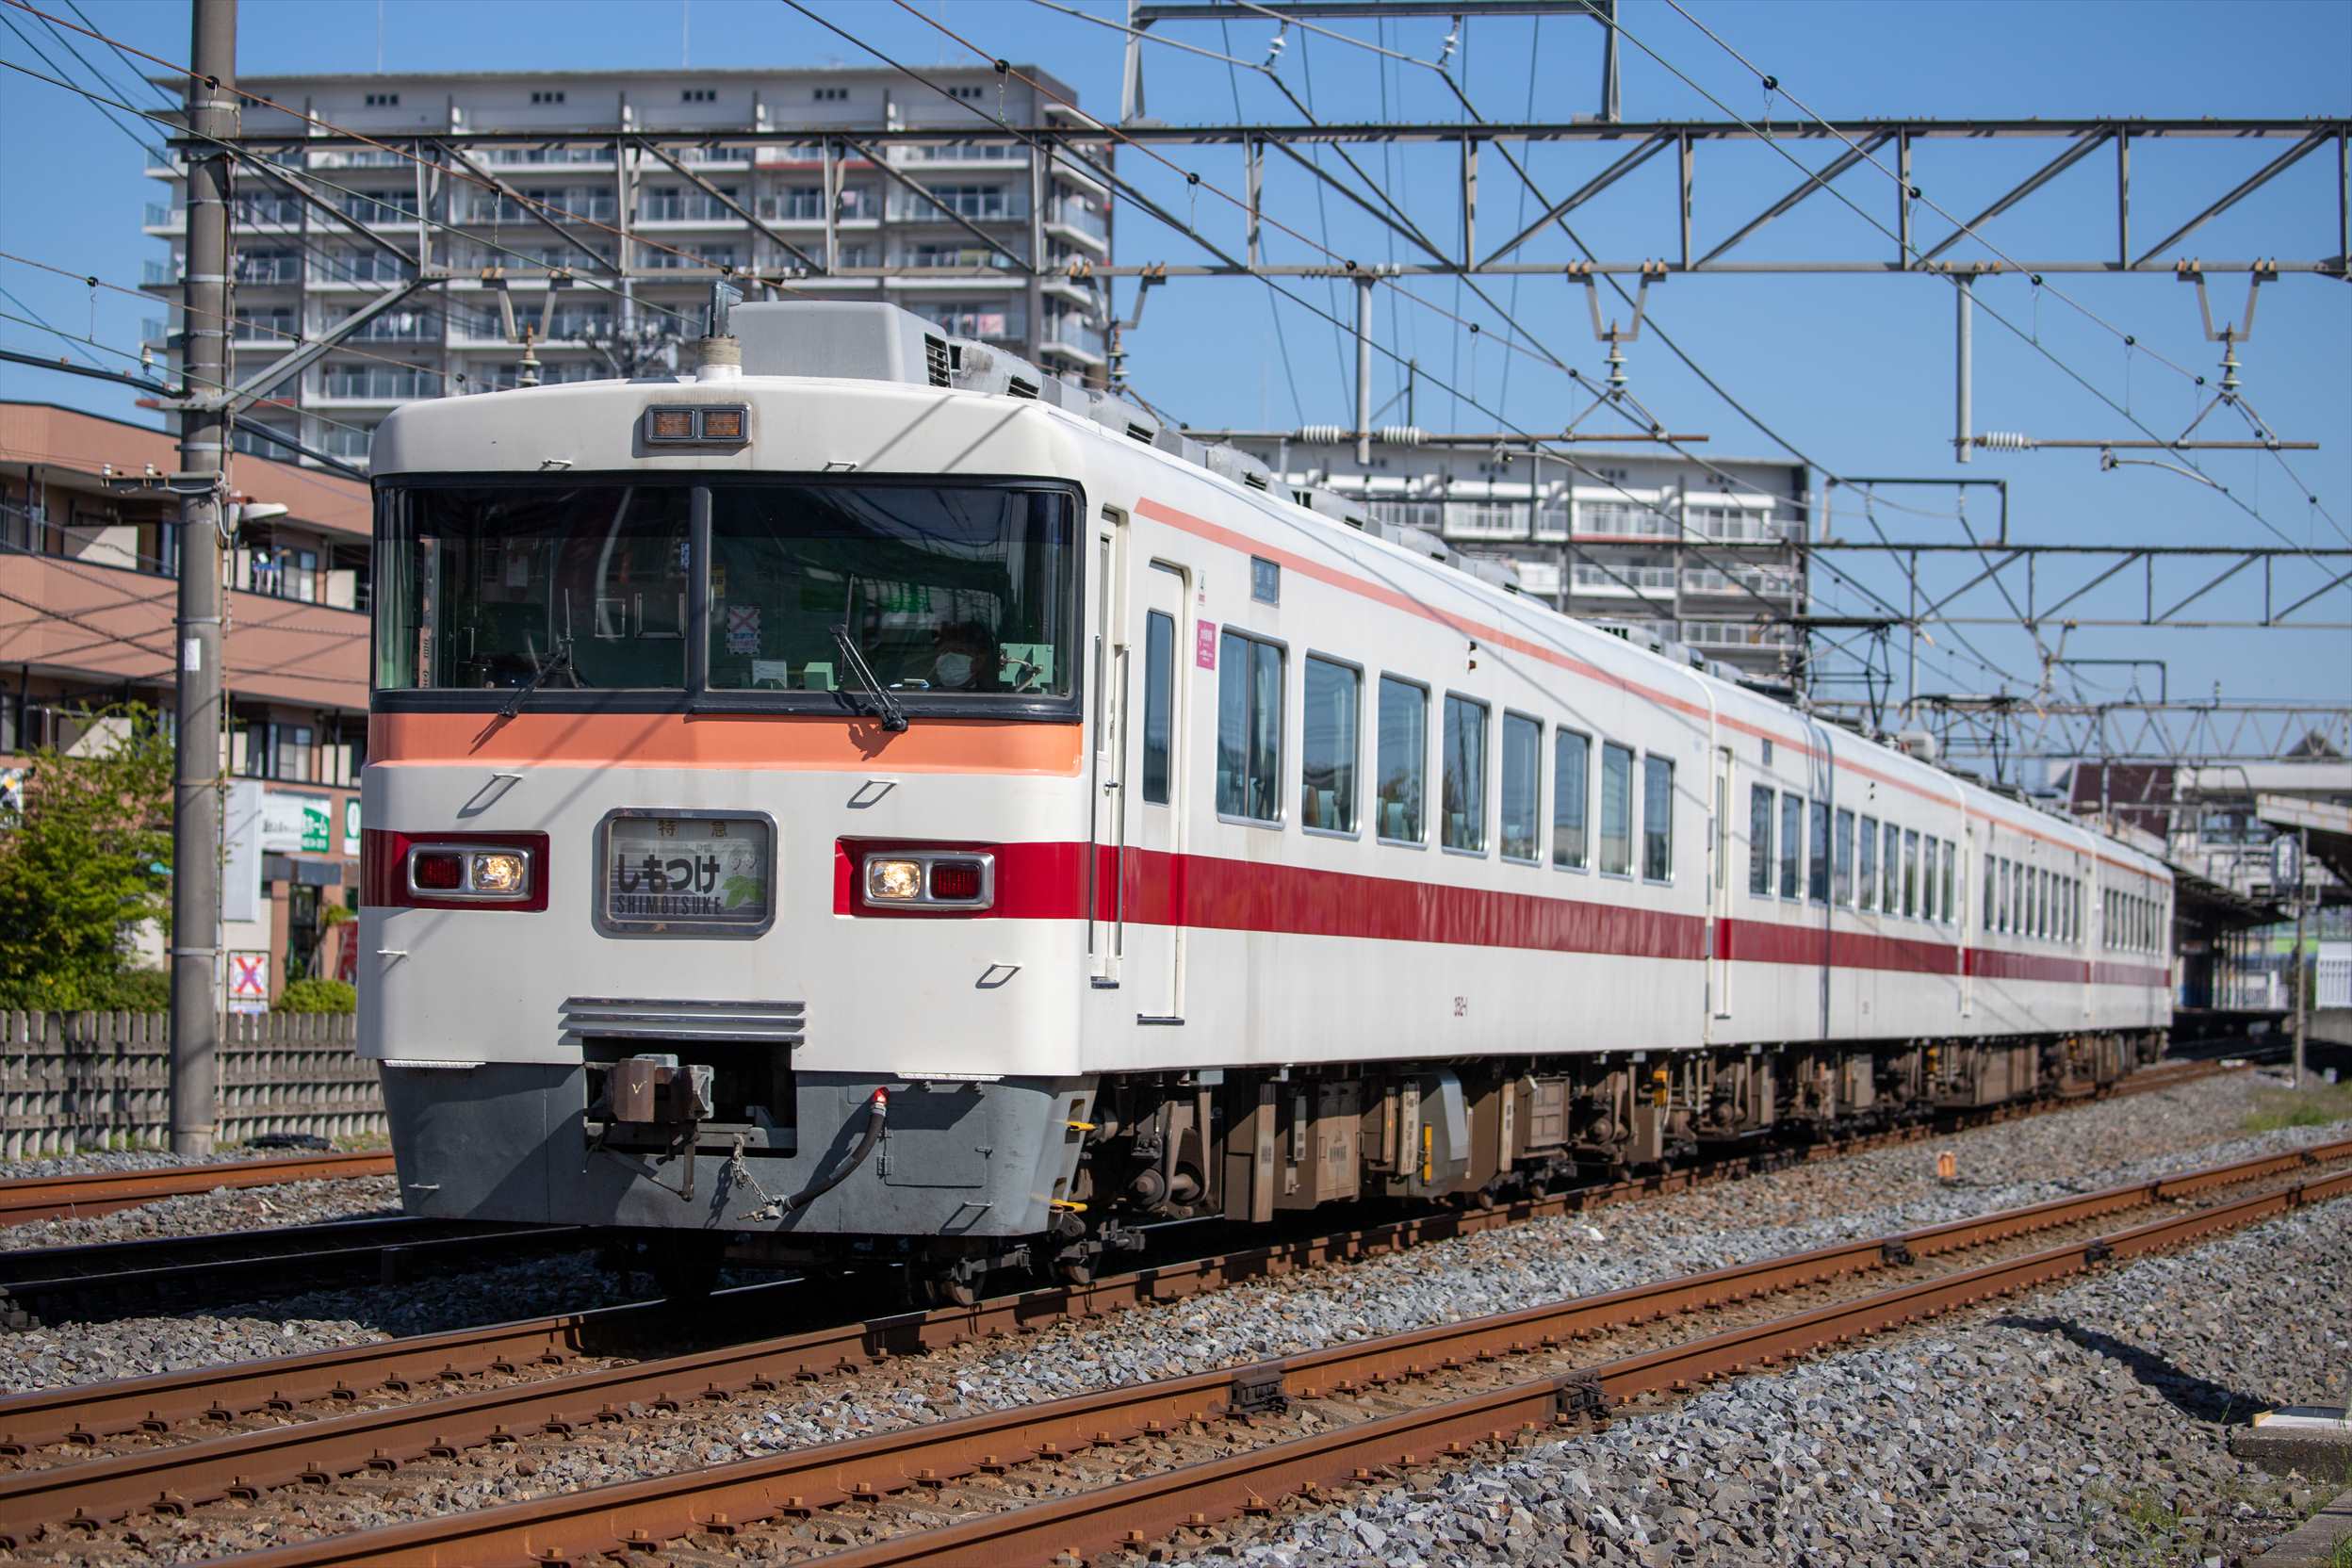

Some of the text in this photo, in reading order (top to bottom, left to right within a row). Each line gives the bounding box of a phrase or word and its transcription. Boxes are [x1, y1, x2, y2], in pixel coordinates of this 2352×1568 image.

[657, 821, 727, 838] 特急
[617, 854, 721, 895] しもつけ
[617, 895, 722, 915] SHIMOTSUKE
